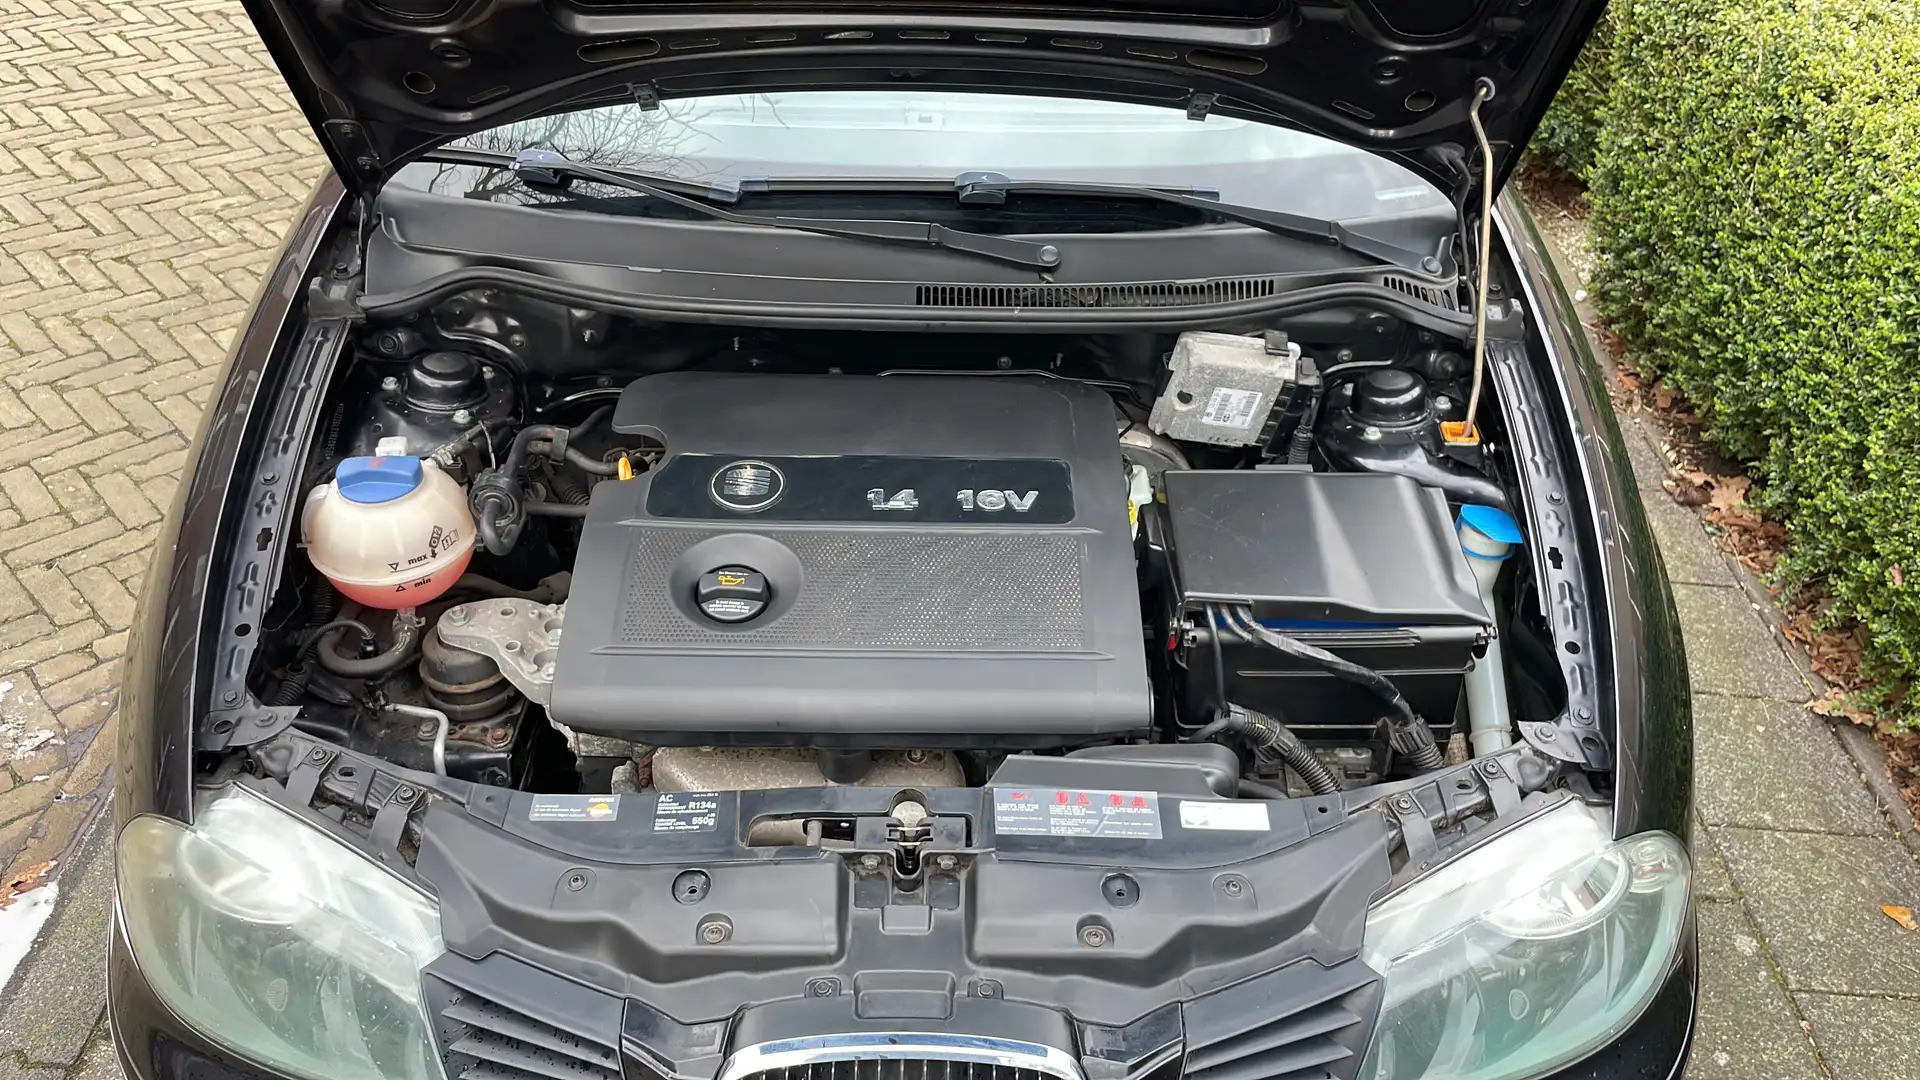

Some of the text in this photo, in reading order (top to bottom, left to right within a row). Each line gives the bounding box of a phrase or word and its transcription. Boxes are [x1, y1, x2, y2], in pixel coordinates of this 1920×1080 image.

[956, 489, 1039, 512] 16V
[408, 554, 428, 565] max
[414, 578, 431, 588] min
[658, 794, 674, 802] AC
[688, 801, 717, 809] R134a
